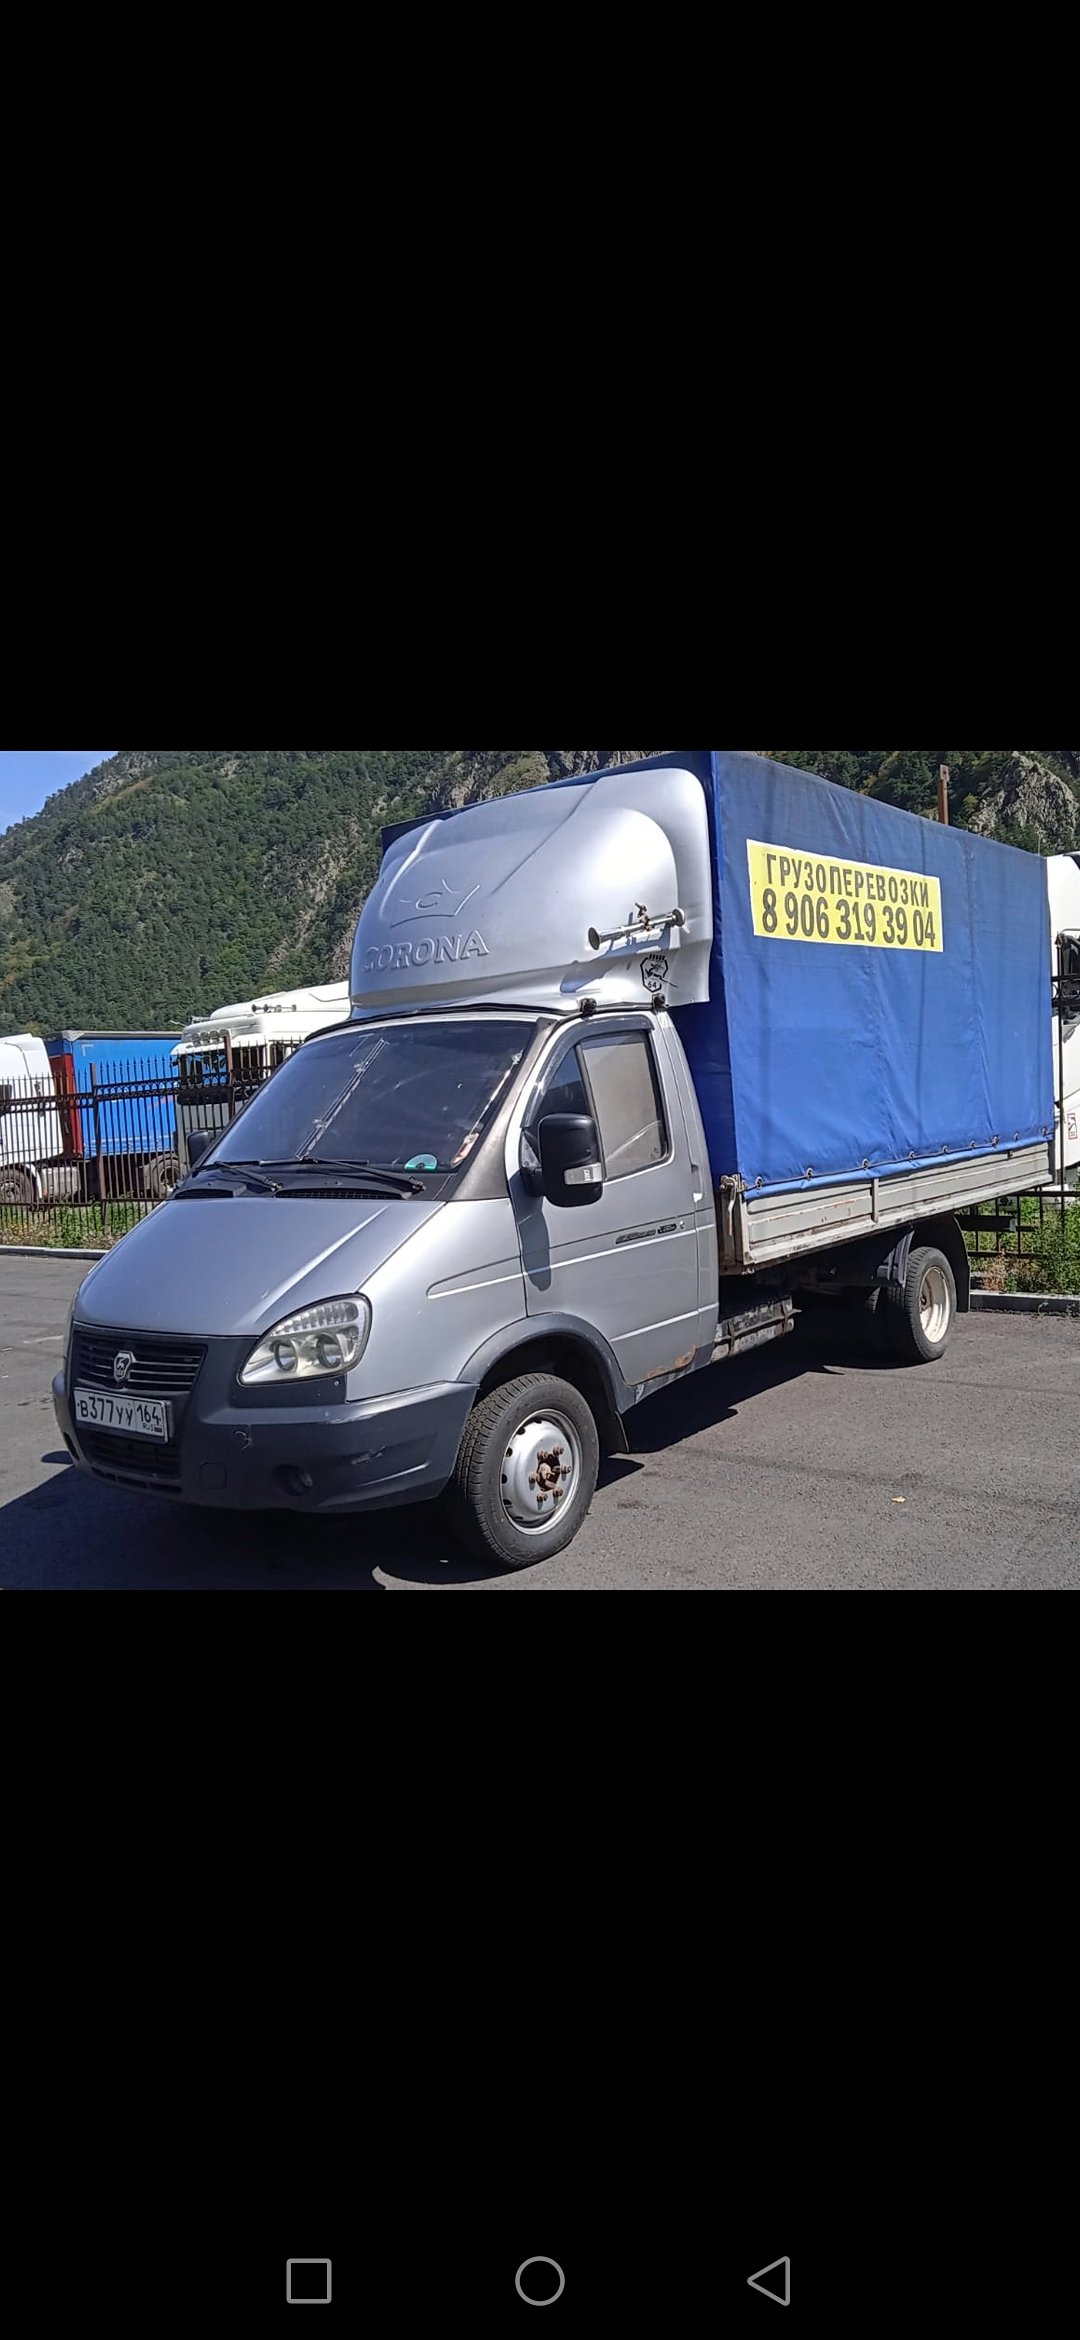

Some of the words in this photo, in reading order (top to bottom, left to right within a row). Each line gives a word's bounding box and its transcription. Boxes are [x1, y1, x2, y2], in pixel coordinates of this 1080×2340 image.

[766, 853, 930, 908] ГРУЗОПЕРЕВОЗКИ
[762, 888, 778, 933] 8
[785, 891, 830, 939] 906
[836, 898, 877, 942] 319
[883, 905, 908, 945] 39
[913, 909, 936, 948] 04
[363, 929, 490, 973] CORONA
[136, 1404, 161, 1425] 164
